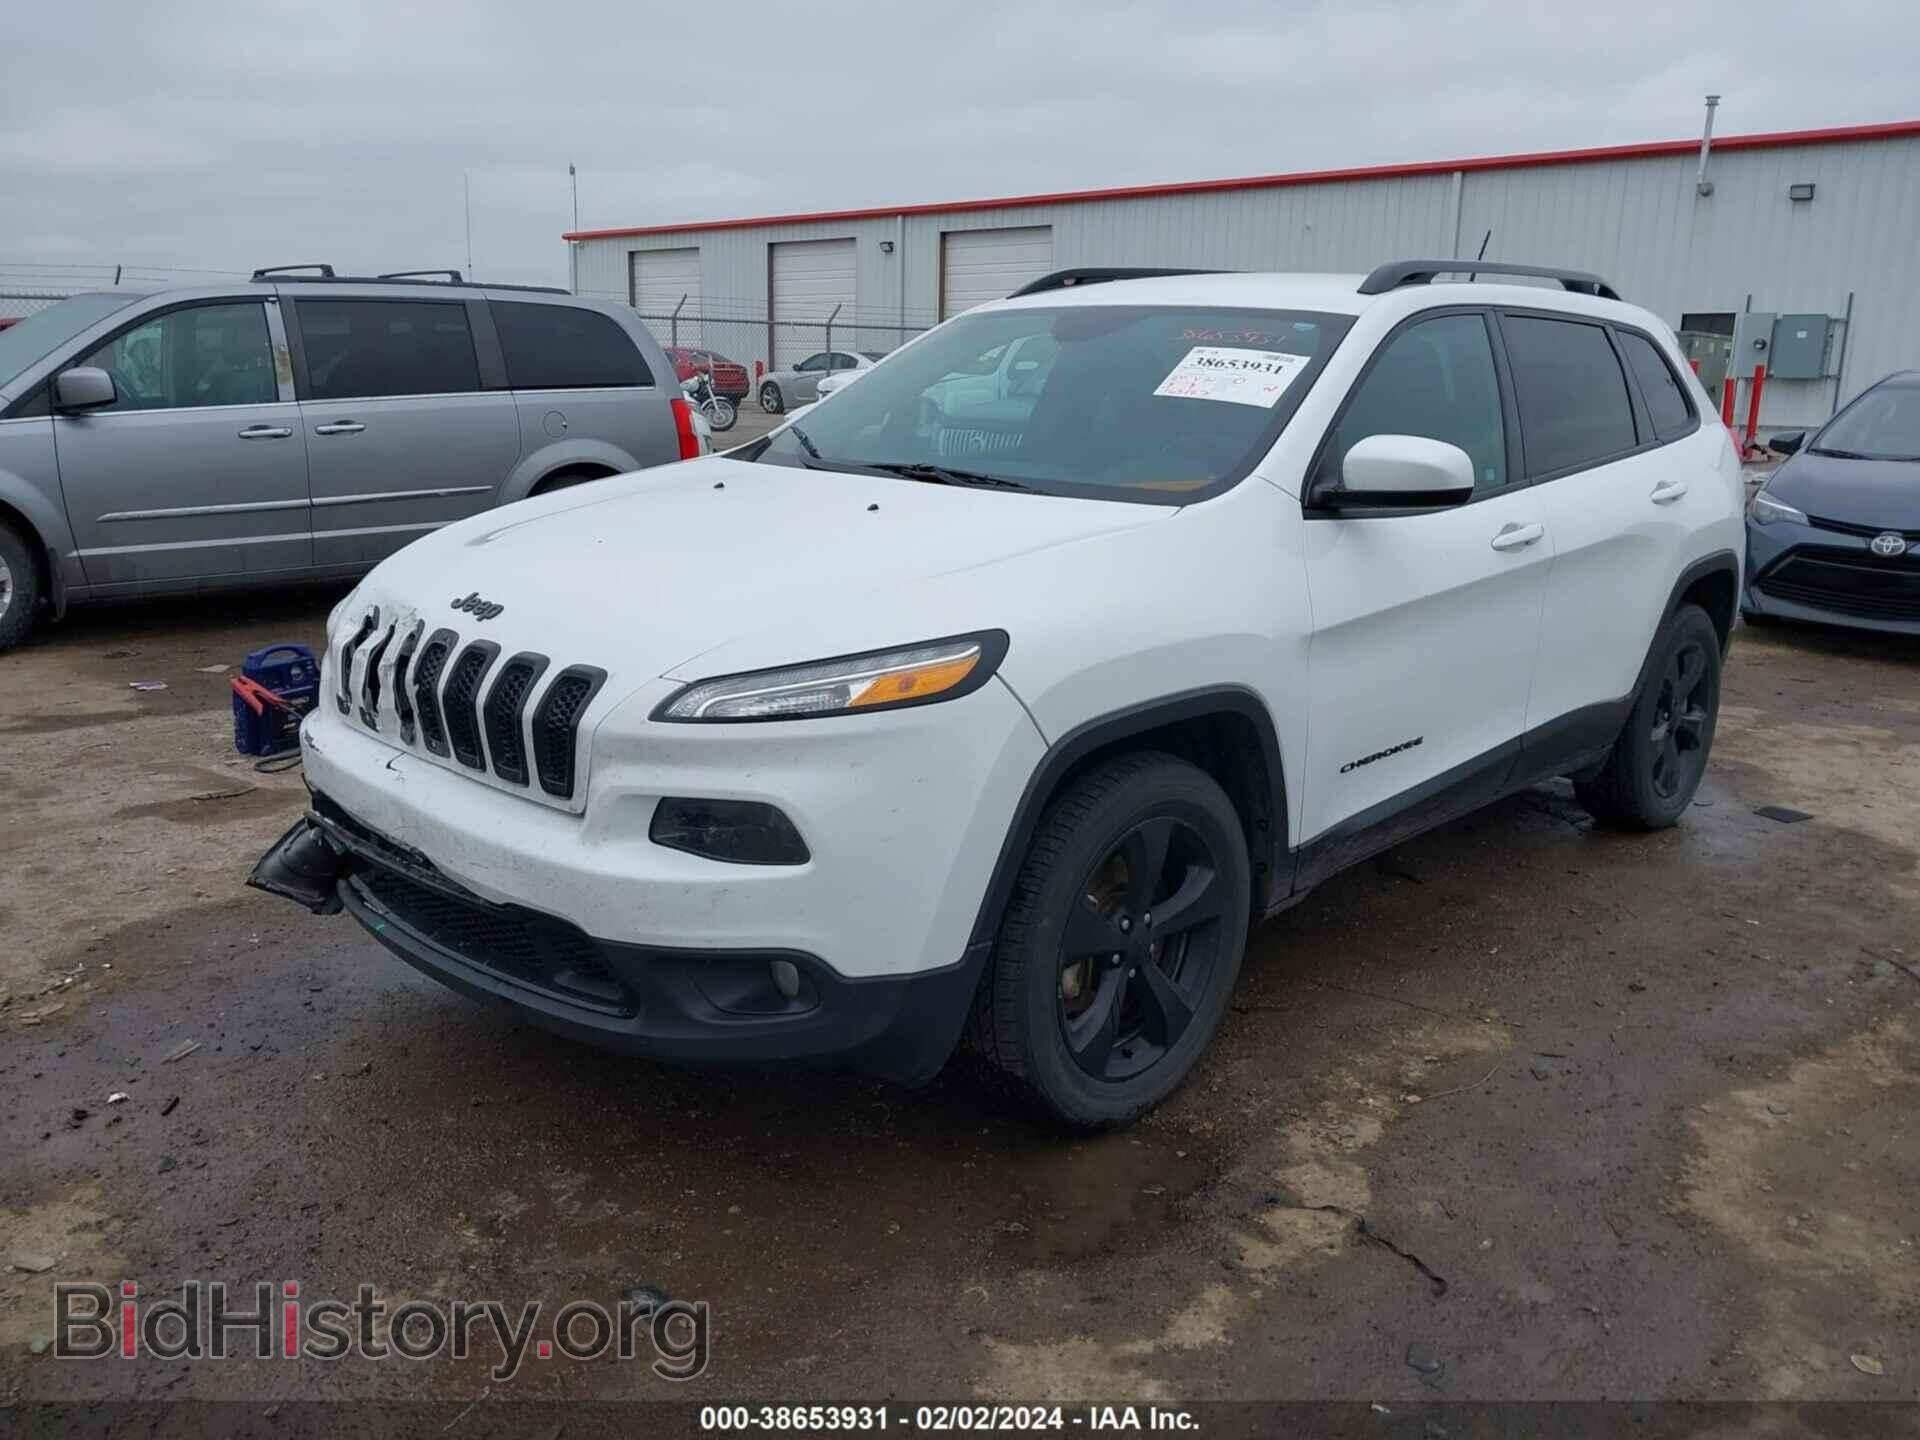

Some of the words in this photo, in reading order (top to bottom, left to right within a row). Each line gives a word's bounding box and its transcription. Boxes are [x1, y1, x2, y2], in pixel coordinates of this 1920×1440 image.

[1196, 356, 1284, 375] 38653931
[451, 592, 504, 622] Jeep
[1340, 736, 1424, 774] CHEROKEE
